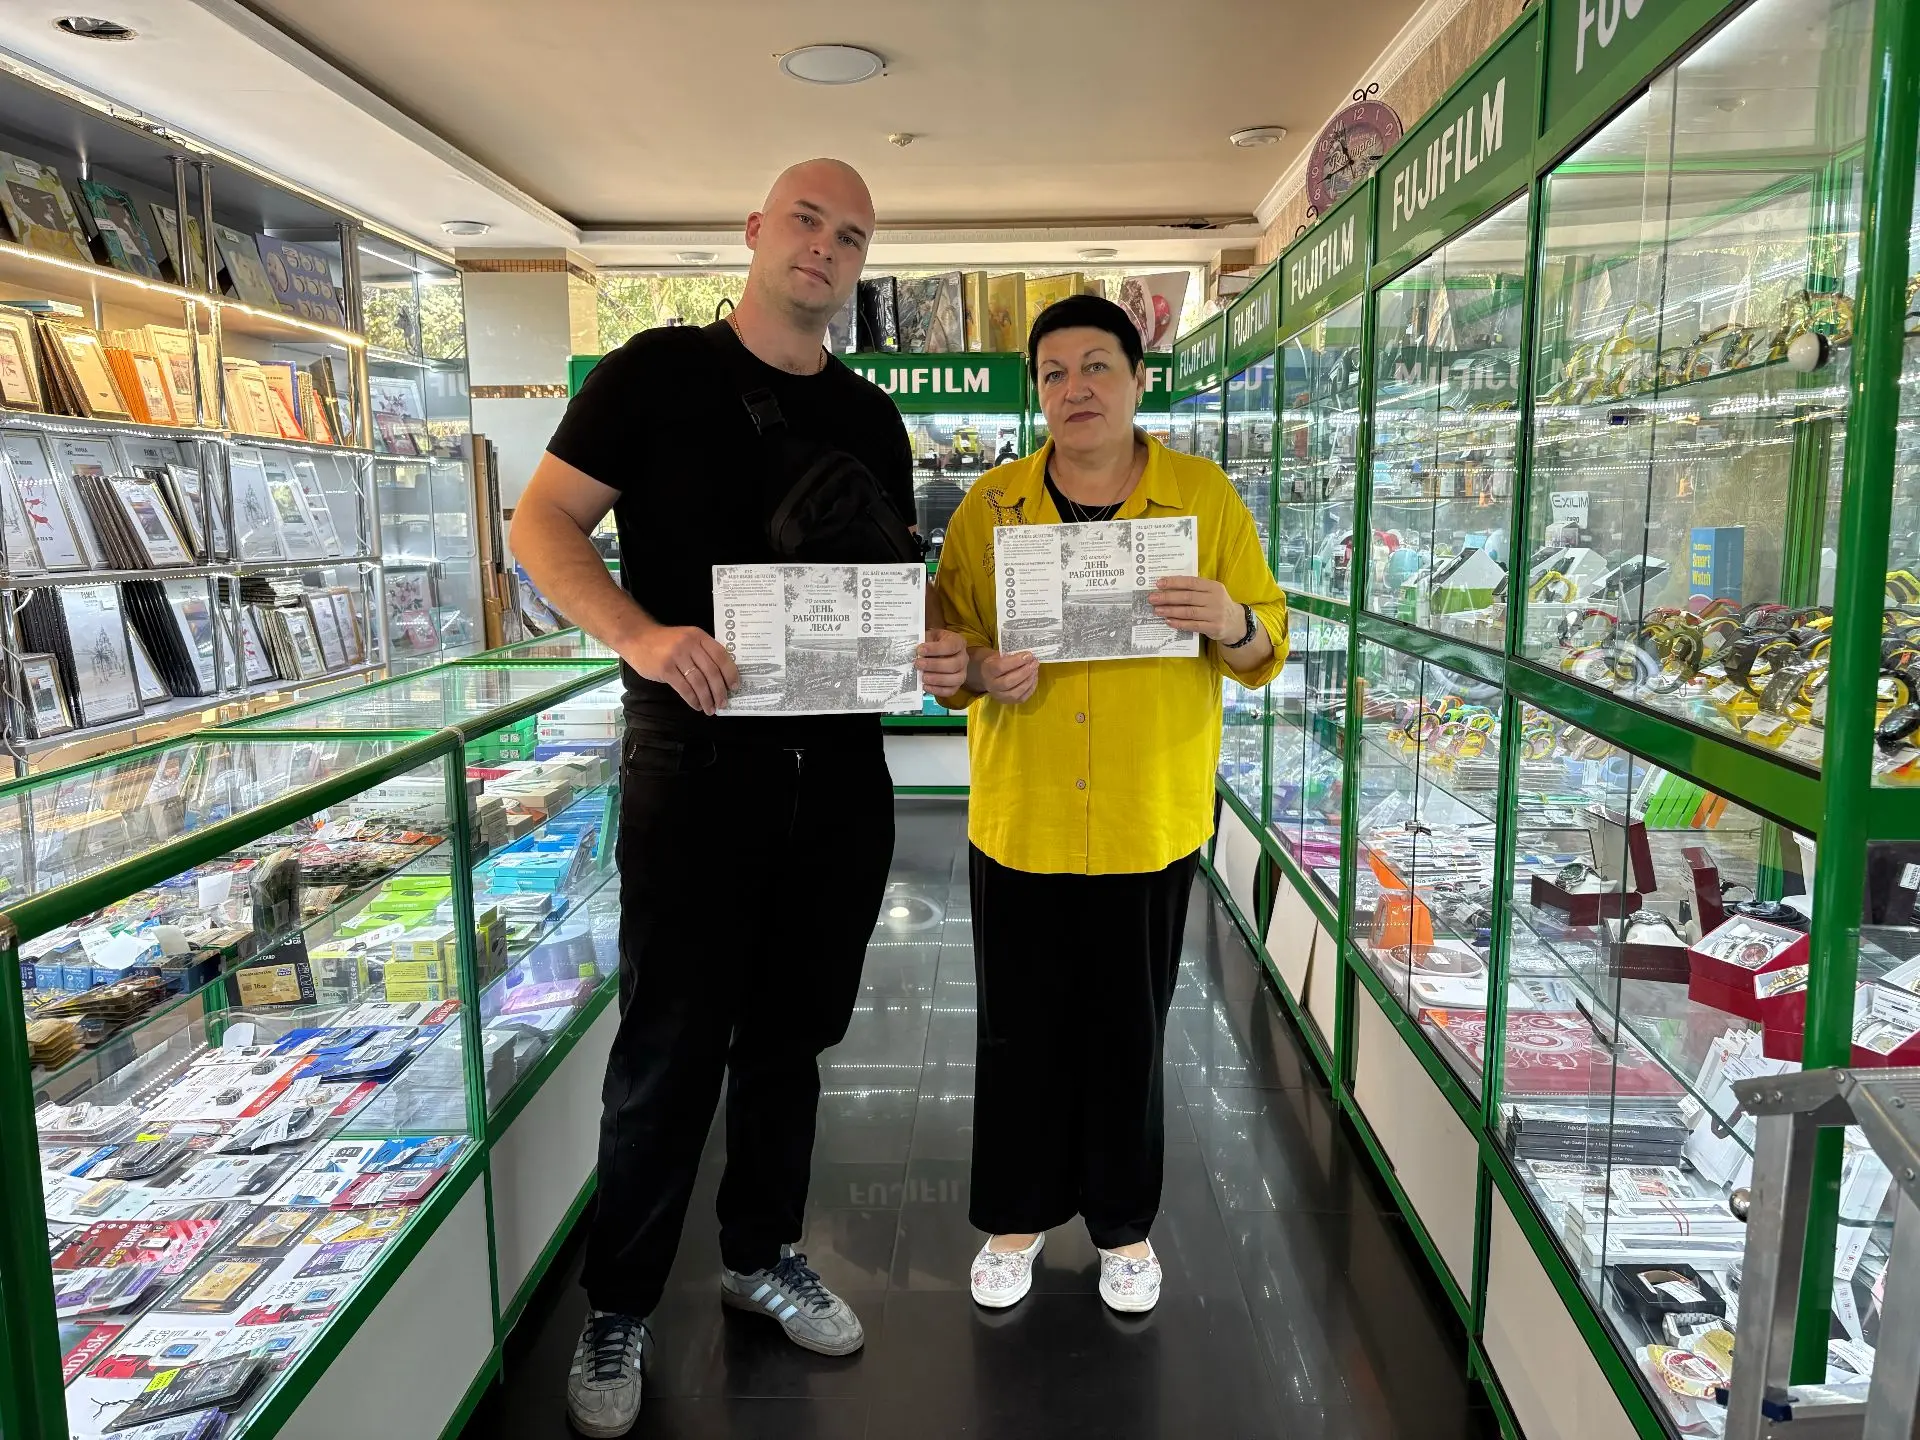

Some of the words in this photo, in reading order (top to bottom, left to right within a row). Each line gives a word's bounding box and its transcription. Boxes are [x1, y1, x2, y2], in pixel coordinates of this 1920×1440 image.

[1392, 77, 1506, 231] FUJIFILM
[1290, 215, 1354, 306] FUJIFILM
[1233, 288, 1271, 350] FUJIFILM
[1179, 333, 1217, 379] FUJIFILM
[855, 367, 990, 394] JIFILM
[1552, 494, 1589, 508] EXILIM
[1069, 569, 1125, 578] РАБОТНИКОВ
[1084, 561, 1109, 570] ДЕНЬ
[1086, 578, 1109, 587] ЛЕСА
[793, 614, 850, 622] РАБОТНИКОВ
[809, 605, 834, 614] ДЕНЬ
[63, 1332, 112, 1381] anDisk
